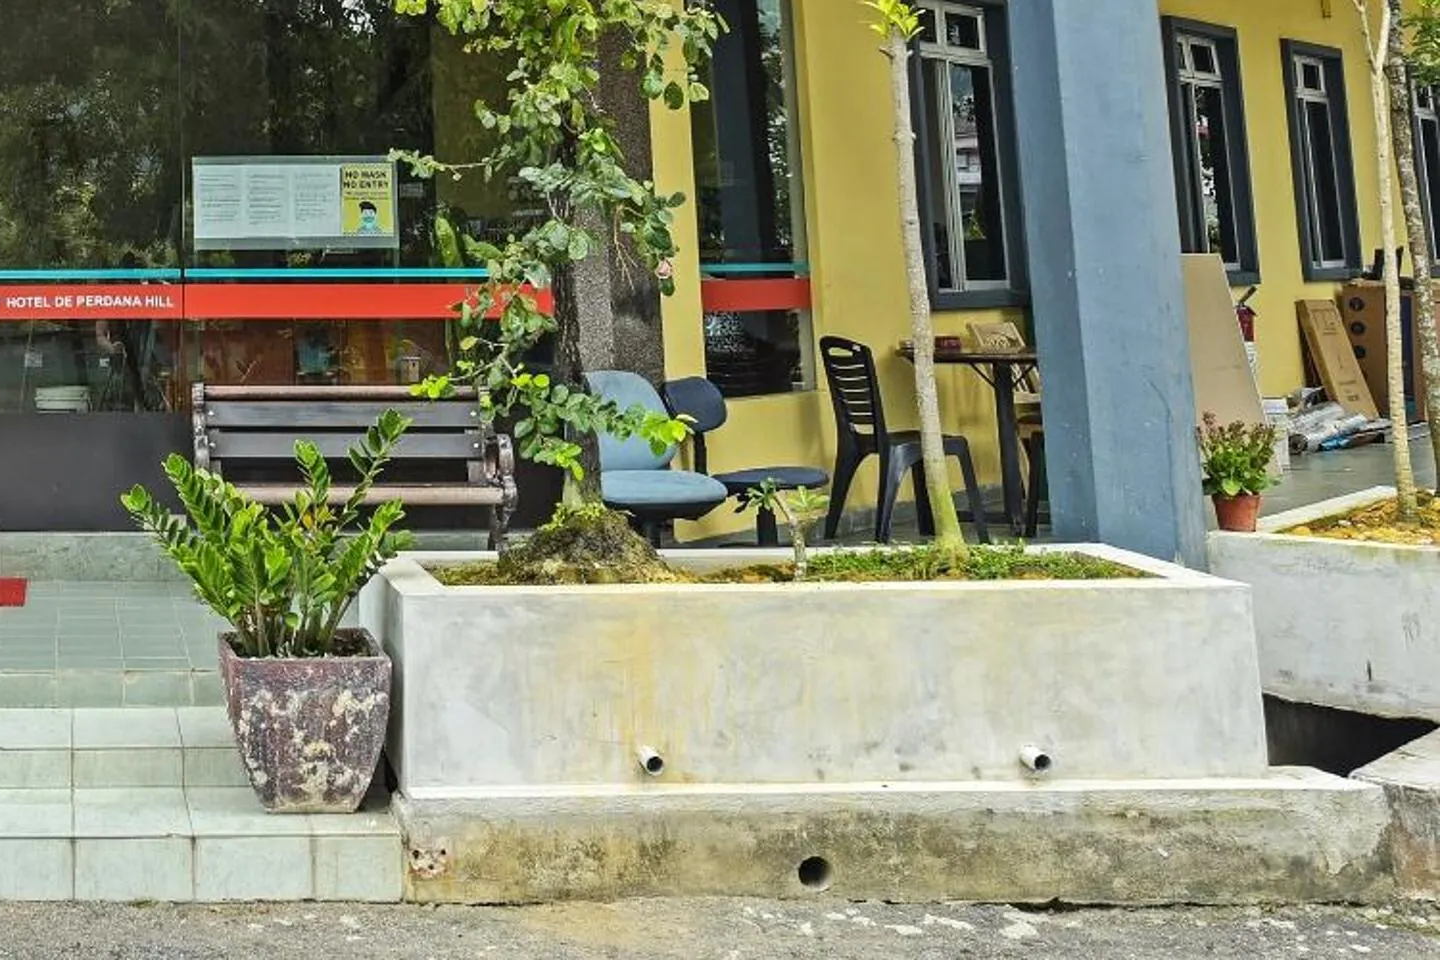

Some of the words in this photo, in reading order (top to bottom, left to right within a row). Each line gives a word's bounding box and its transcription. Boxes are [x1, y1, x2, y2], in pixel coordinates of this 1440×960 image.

[6, 296, 51, 309] HOTEL
[55, 296, 74, 308] DE
[76, 295, 142, 308] PERDANA
[145, 295, 174, 308] HILL
